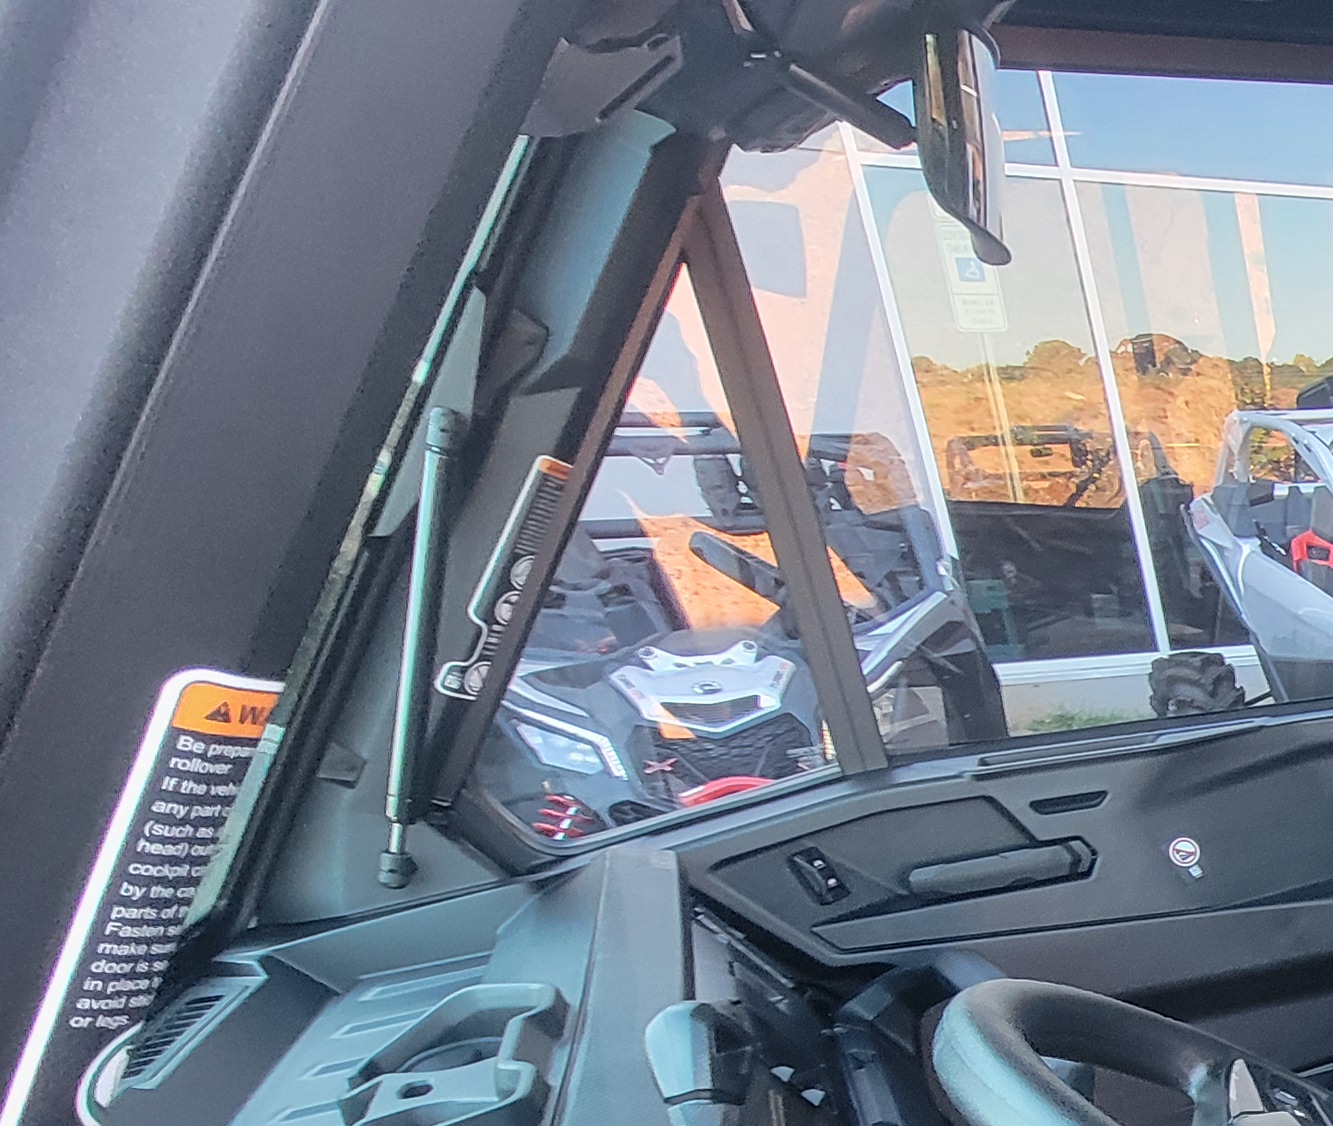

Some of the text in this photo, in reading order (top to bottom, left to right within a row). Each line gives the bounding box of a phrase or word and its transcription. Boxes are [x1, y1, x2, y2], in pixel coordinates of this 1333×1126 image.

[175, 735, 205, 753] Be
[169, 757, 234, 775] rollover
[161, 776, 178, 791] If
[180, 779, 207, 795] the
[151, 801, 189, 819] any
[190, 804, 221, 820] part
[136, 838, 189, 858] head)
[128, 863, 190, 880] cockpit
[120, 882, 147, 900] by
[149, 885, 175, 898] the
[110, 905, 158, 920] parts
[104, 922, 165, 938] Fasten
[97, 942, 148, 956] make
[90, 959, 135, 974] door
[135, 959, 149, 973] is
[82, 976, 103, 991] in
[107, 978, 150, 994] place
[76, 995, 127, 1010] avoid
[69, 1015, 94, 1029] or
